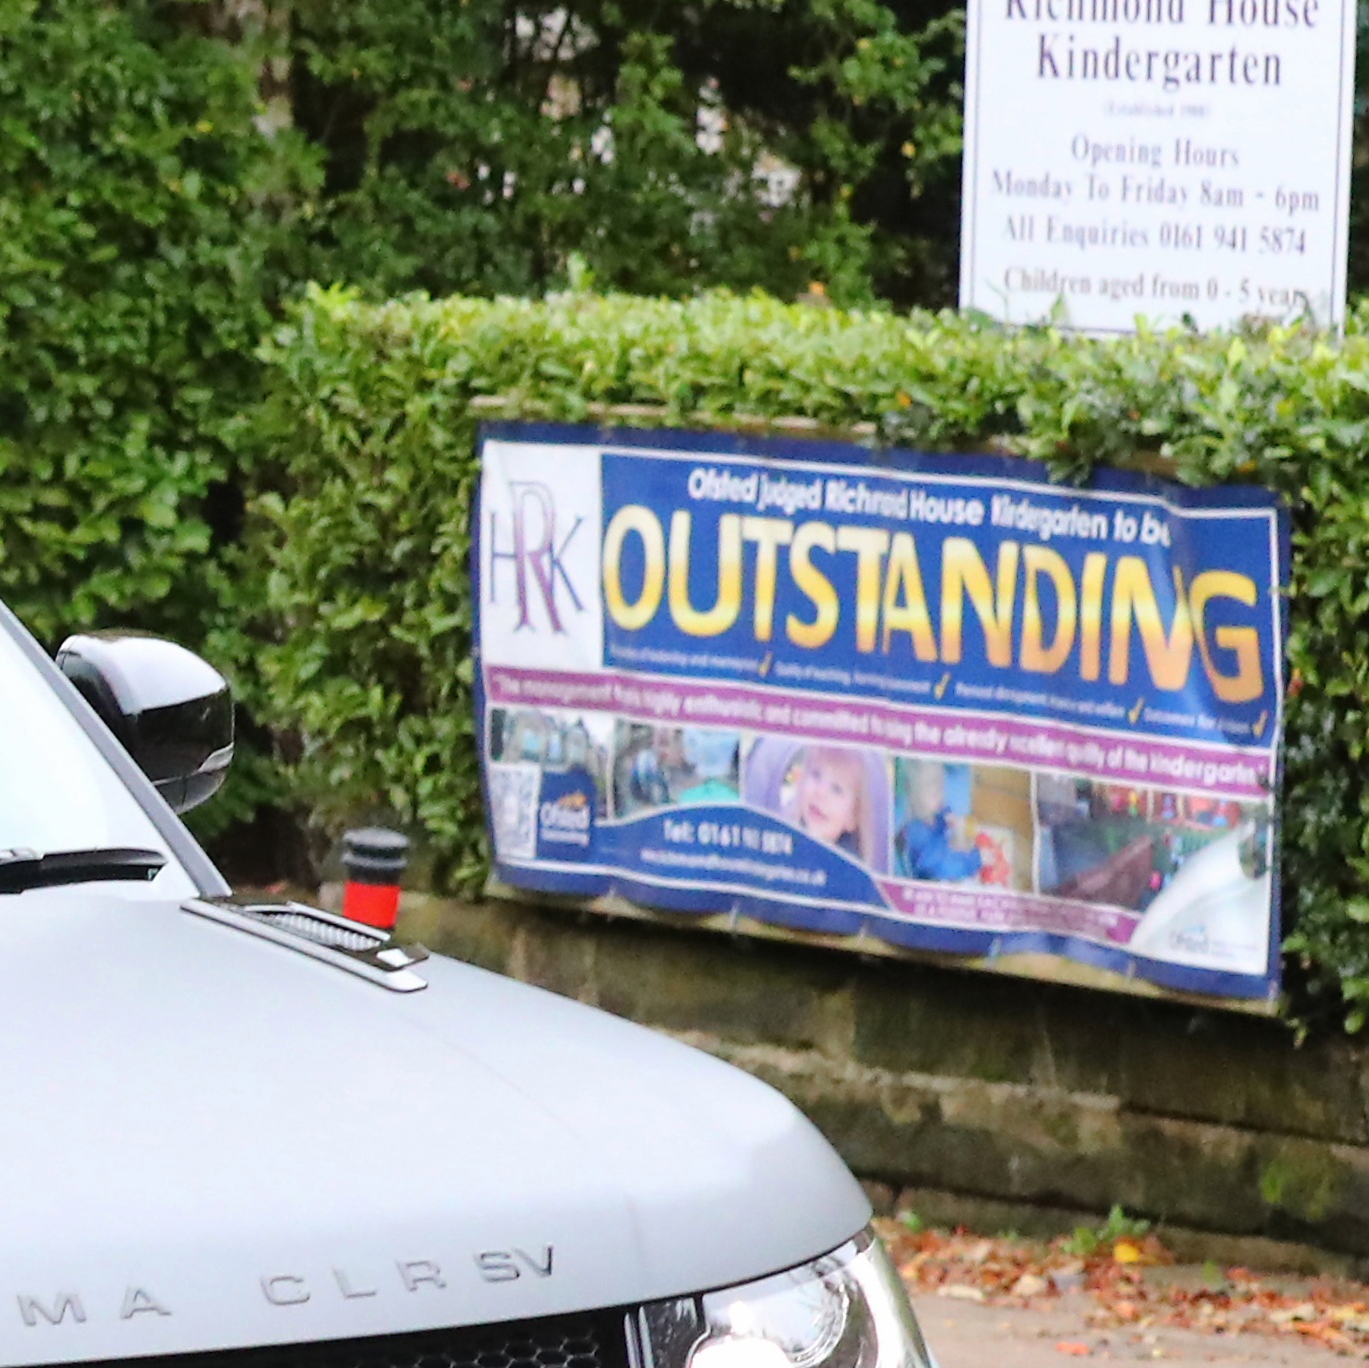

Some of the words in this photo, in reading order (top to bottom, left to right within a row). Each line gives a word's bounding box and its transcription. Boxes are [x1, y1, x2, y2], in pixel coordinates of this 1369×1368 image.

[1207, 0, 1320, 27] House
[1037, 32, 1282, 91] Kindergarten
[1071, 133, 1162, 169] Opening
[1175, 137, 1240, 168] Hours
[992, 169, 1073, 202] Monday
[1086, 173, 1110, 200] To
[1120, 175, 1189, 208] Friday
[1200, 178, 1244, 208] 8am
[1275, 187, 1320, 217] 6pm
[1003, 215, 1034, 243] All
[1046, 217, 1149, 250] Enquiries
[1160, 222, 1202, 250] 0161
[1214, 225, 1247, 252] 941
[1004, 266, 1091, 296] Children
[1098, 270, 1144, 301] aged
[1152, 273, 1200, 301] from
[1207, 277, 1219, 300] 0
[1239, 277, 1250, 302] 5
[909, 489, 985, 527] House
[1113, 508, 1138, 543] to
[601, 503, 1266, 703] OUTSTANDING
